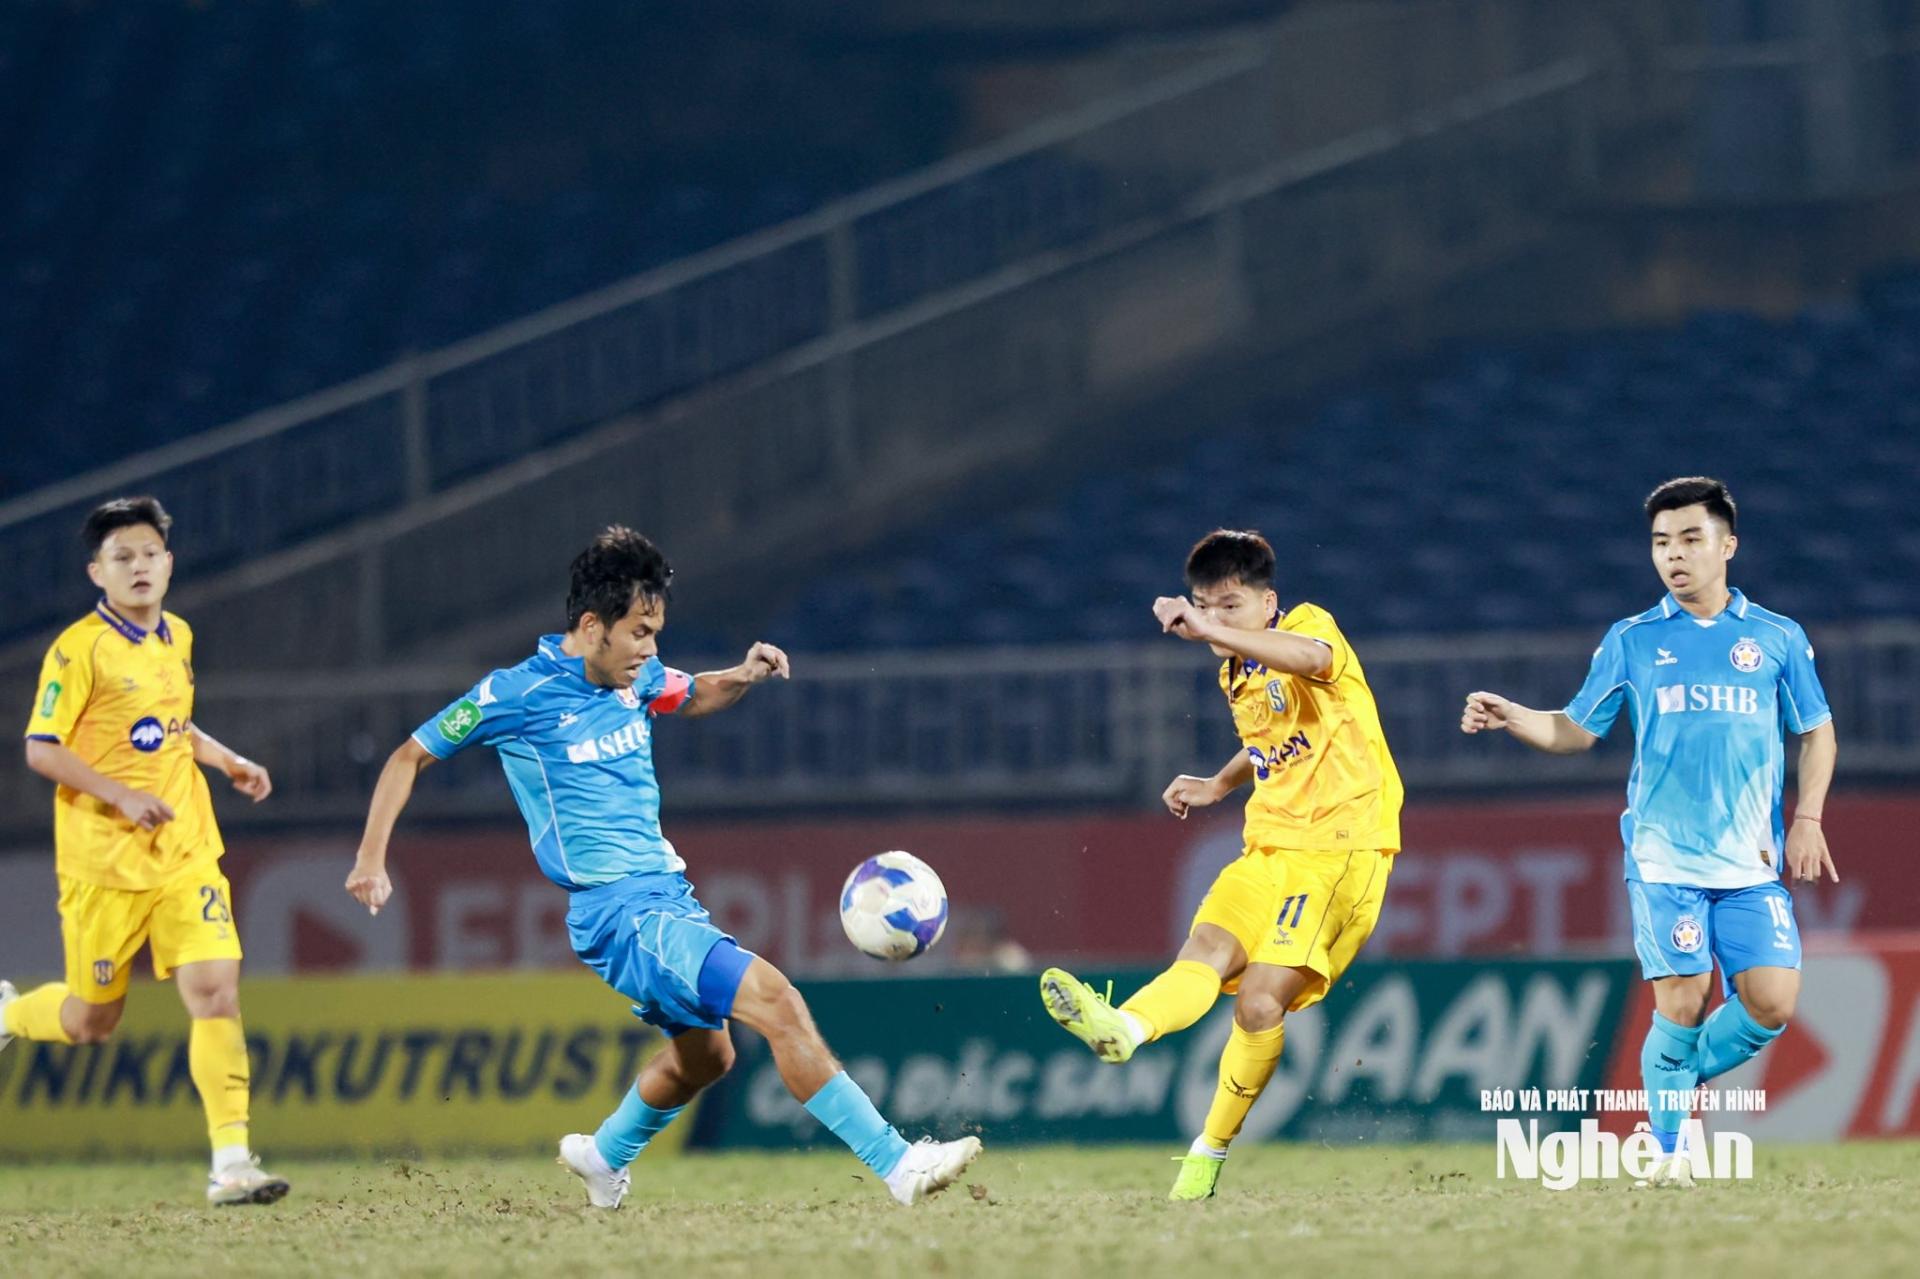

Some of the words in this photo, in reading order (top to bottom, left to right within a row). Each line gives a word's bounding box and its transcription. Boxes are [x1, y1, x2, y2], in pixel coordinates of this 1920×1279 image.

[1689, 684, 1758, 715] SHB
[1276, 893, 1309, 929] 11
[1764, 895, 1791, 930] 16
